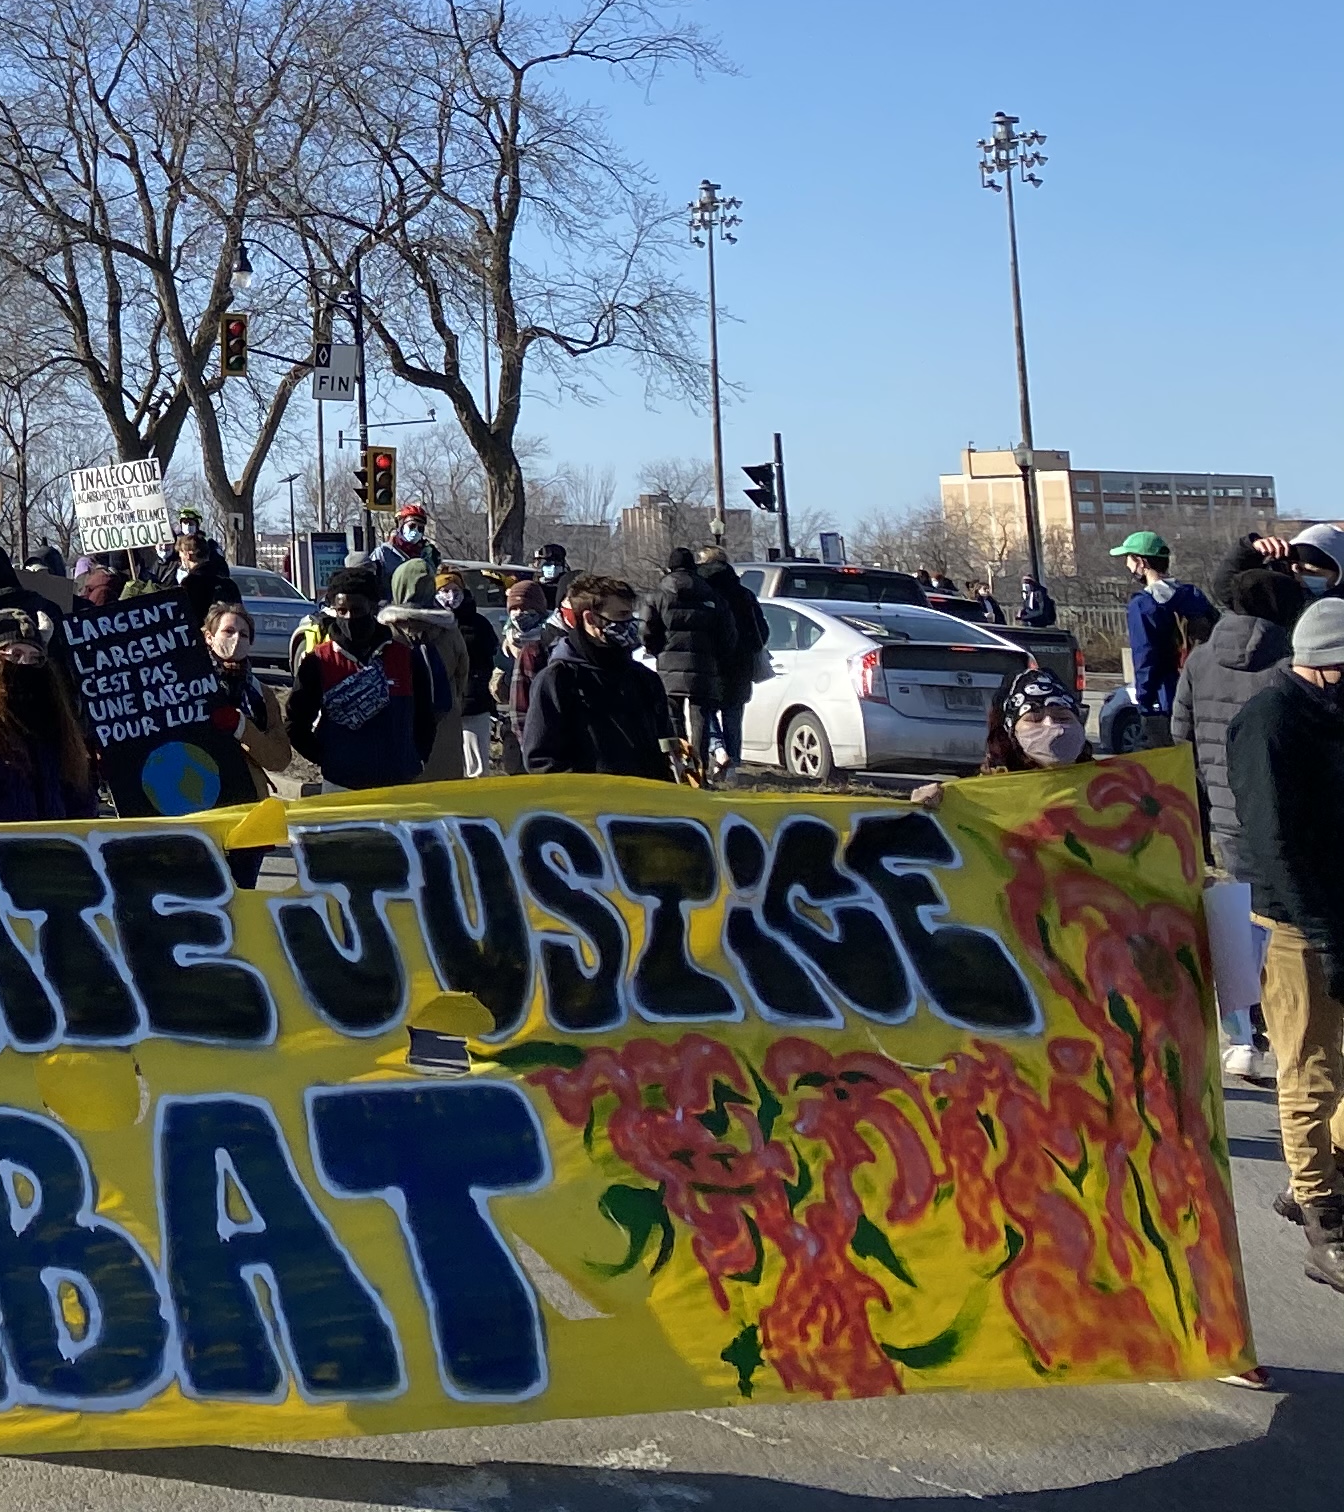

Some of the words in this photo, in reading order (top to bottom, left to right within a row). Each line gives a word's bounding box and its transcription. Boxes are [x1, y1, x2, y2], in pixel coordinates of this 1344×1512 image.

[319, 376, 350, 392] FIN
[81, 671, 131, 697] C'EST
[139, 662, 178, 686] PAS
[88, 693, 138, 721] UNE
[142, 674, 219, 711] RAISON
[96, 716, 161, 747] POUR
[165, 698, 210, 727] LUI
